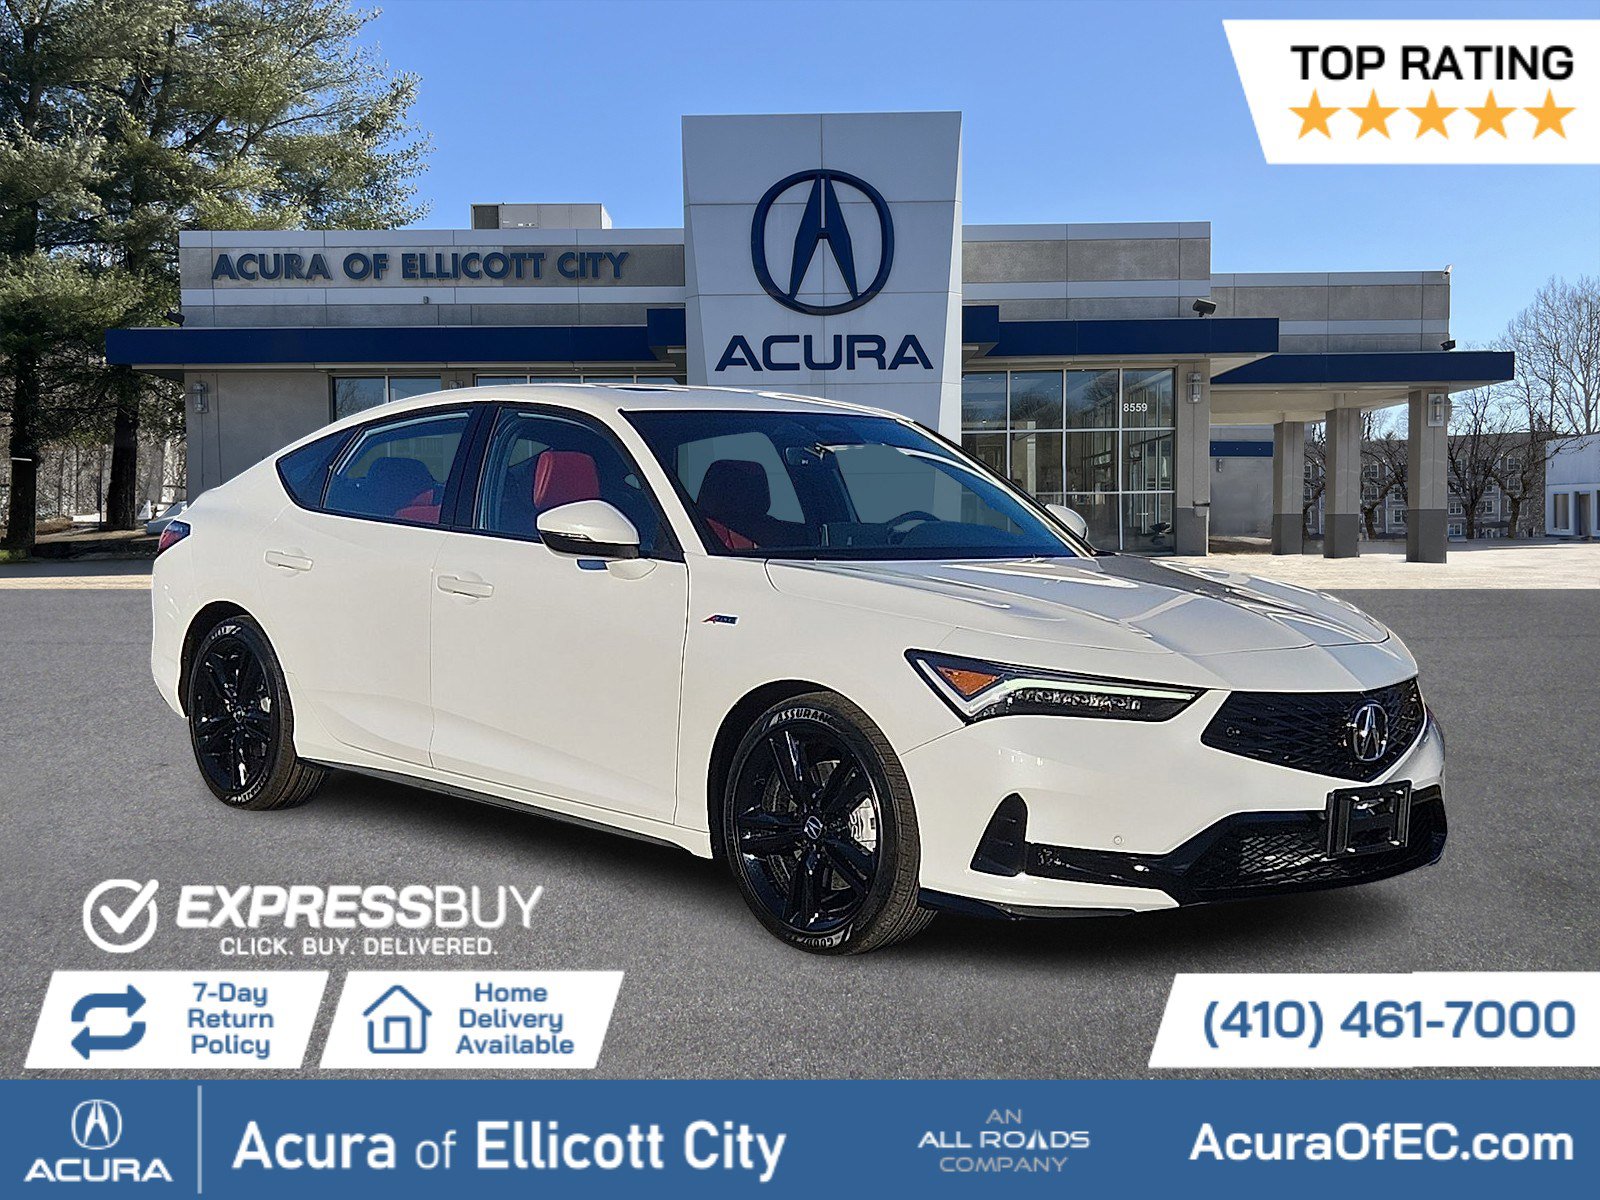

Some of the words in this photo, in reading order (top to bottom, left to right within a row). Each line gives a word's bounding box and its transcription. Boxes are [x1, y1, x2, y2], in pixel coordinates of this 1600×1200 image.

[211, 252, 333, 281] ACURA
[343, 252, 390, 280] OF
[401, 251, 546, 281] ELLICOTT
[557, 251, 630, 280] CITY
[715, 335, 933, 371] ACURA
[1123, 402, 1148, 412] 8559
